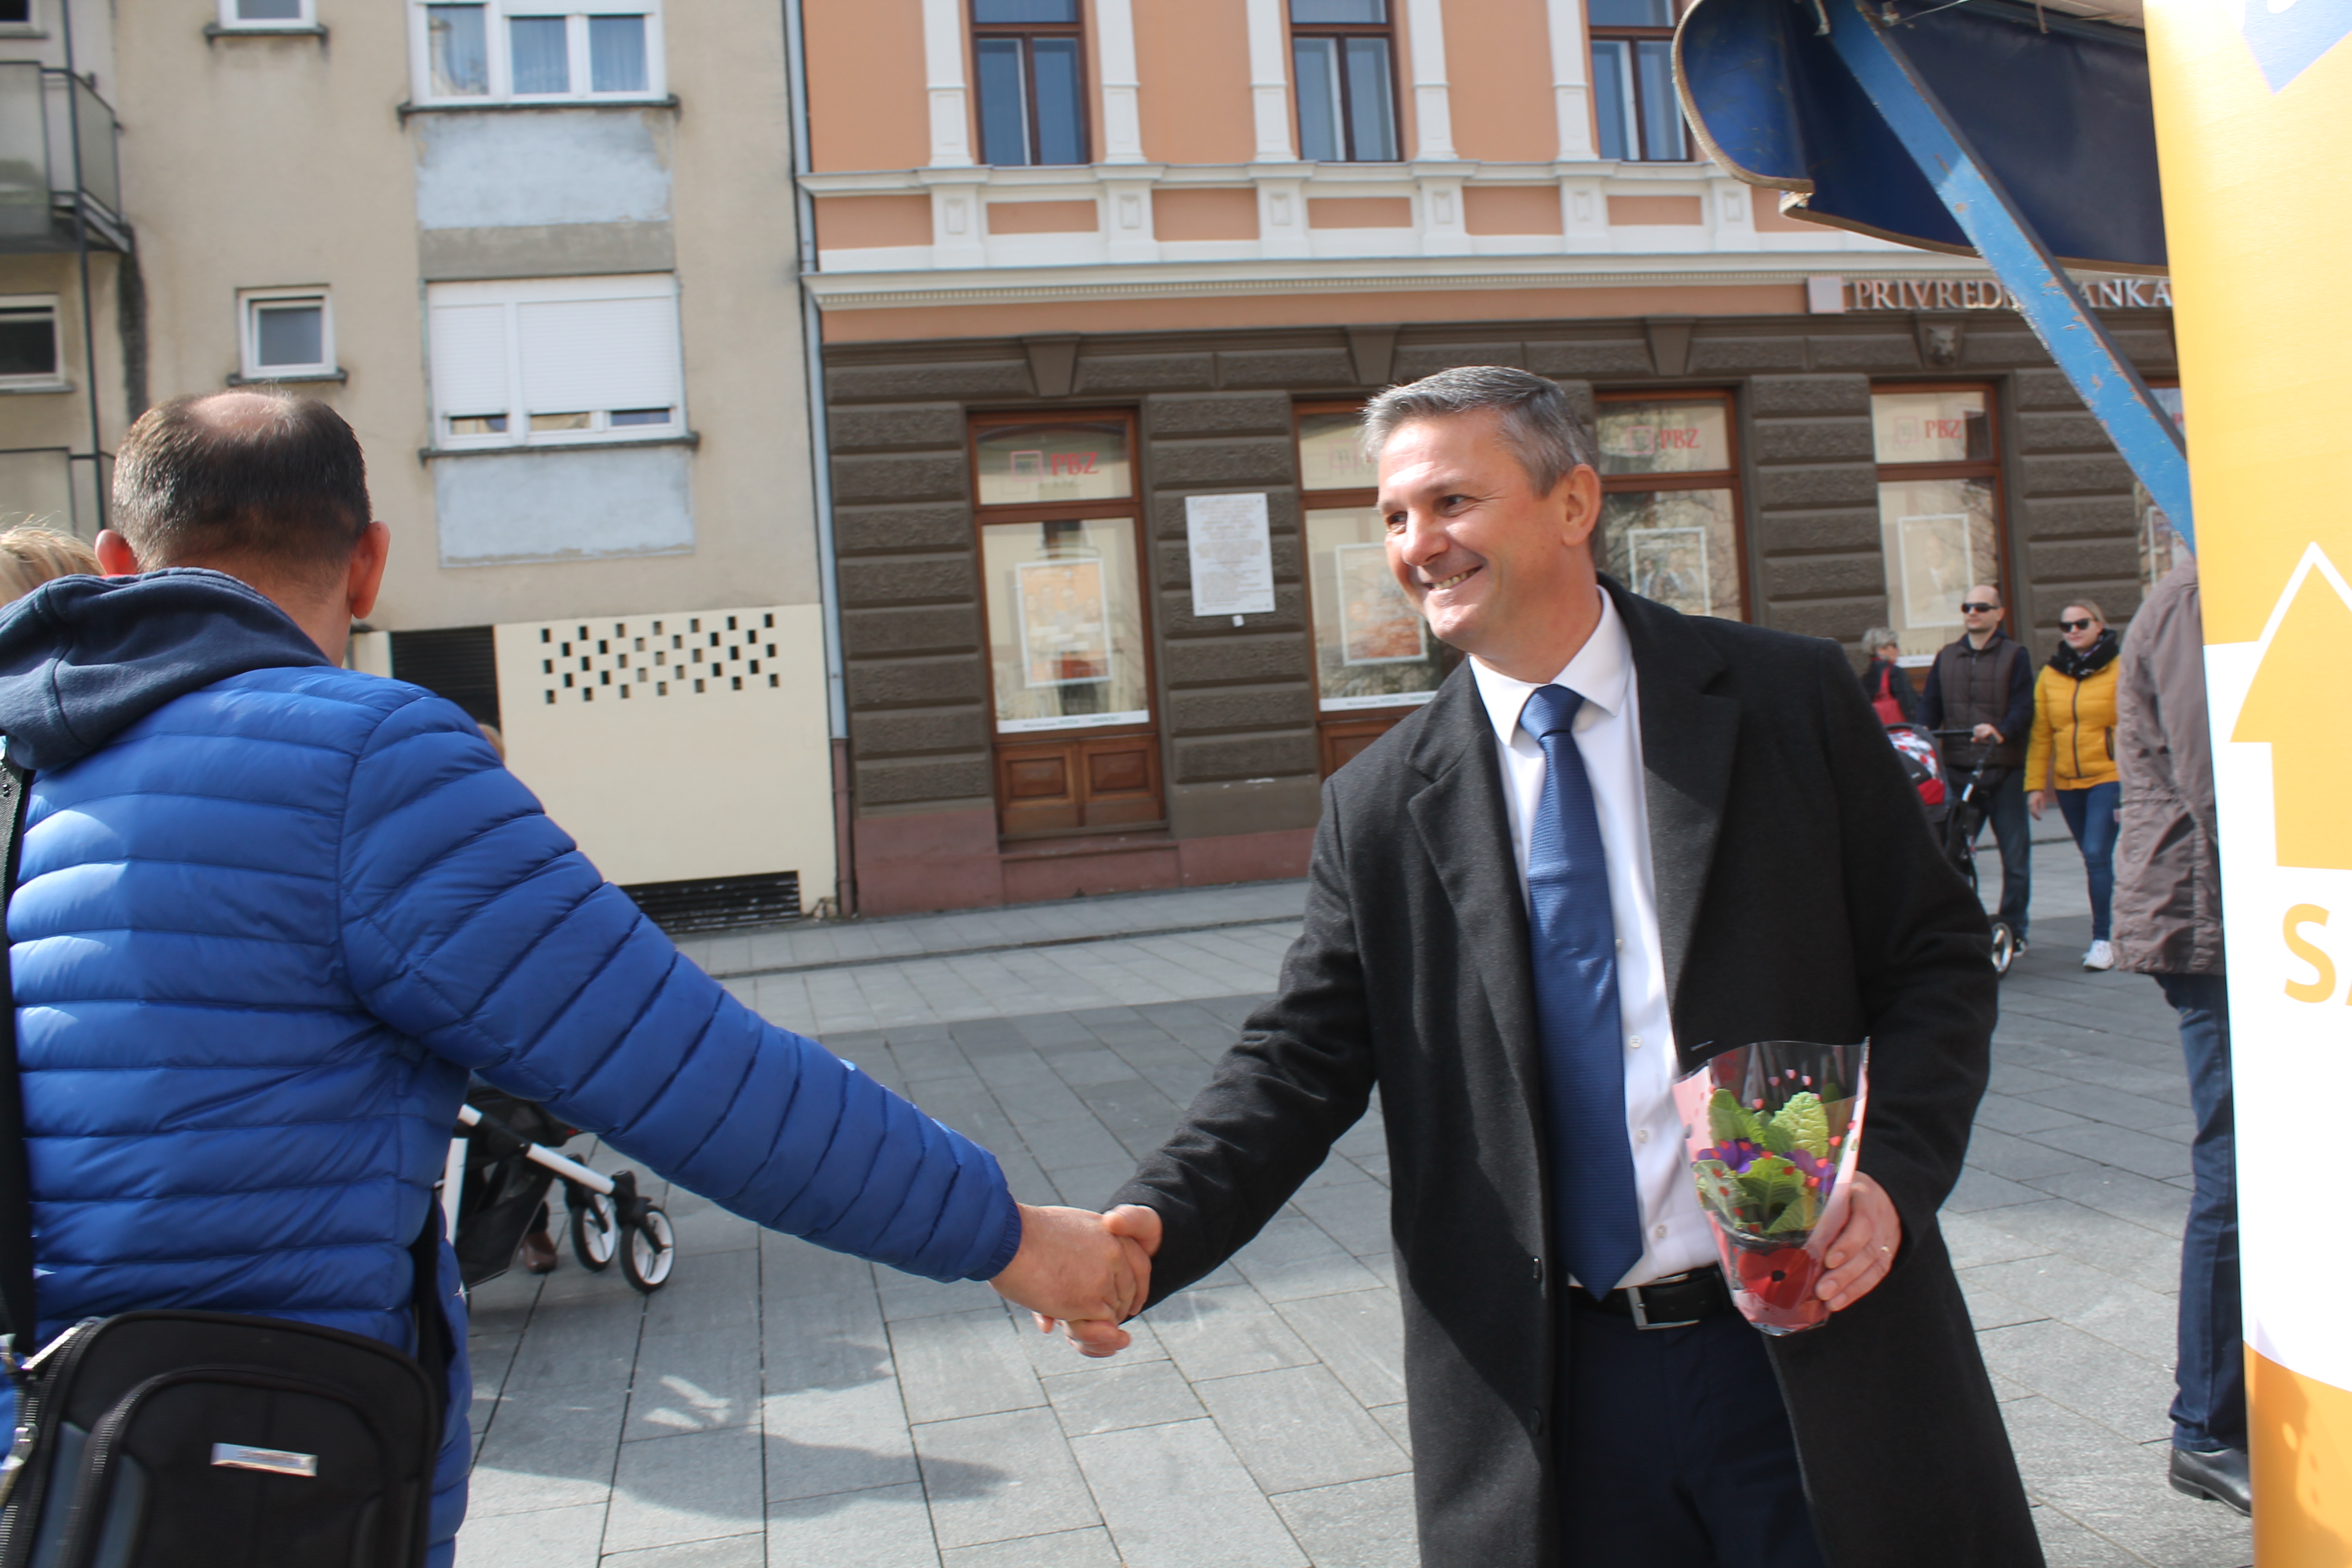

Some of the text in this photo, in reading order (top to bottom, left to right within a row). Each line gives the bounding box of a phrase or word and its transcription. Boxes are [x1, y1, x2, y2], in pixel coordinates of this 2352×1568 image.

[2078, 279, 2173, 308] ANKA
[1660, 428, 1701, 449] PBZ
[1924, 419, 1963, 438] PBZ
[1050, 451, 1099, 475] PBZ
[2282, 901, 2351, 1006] S
